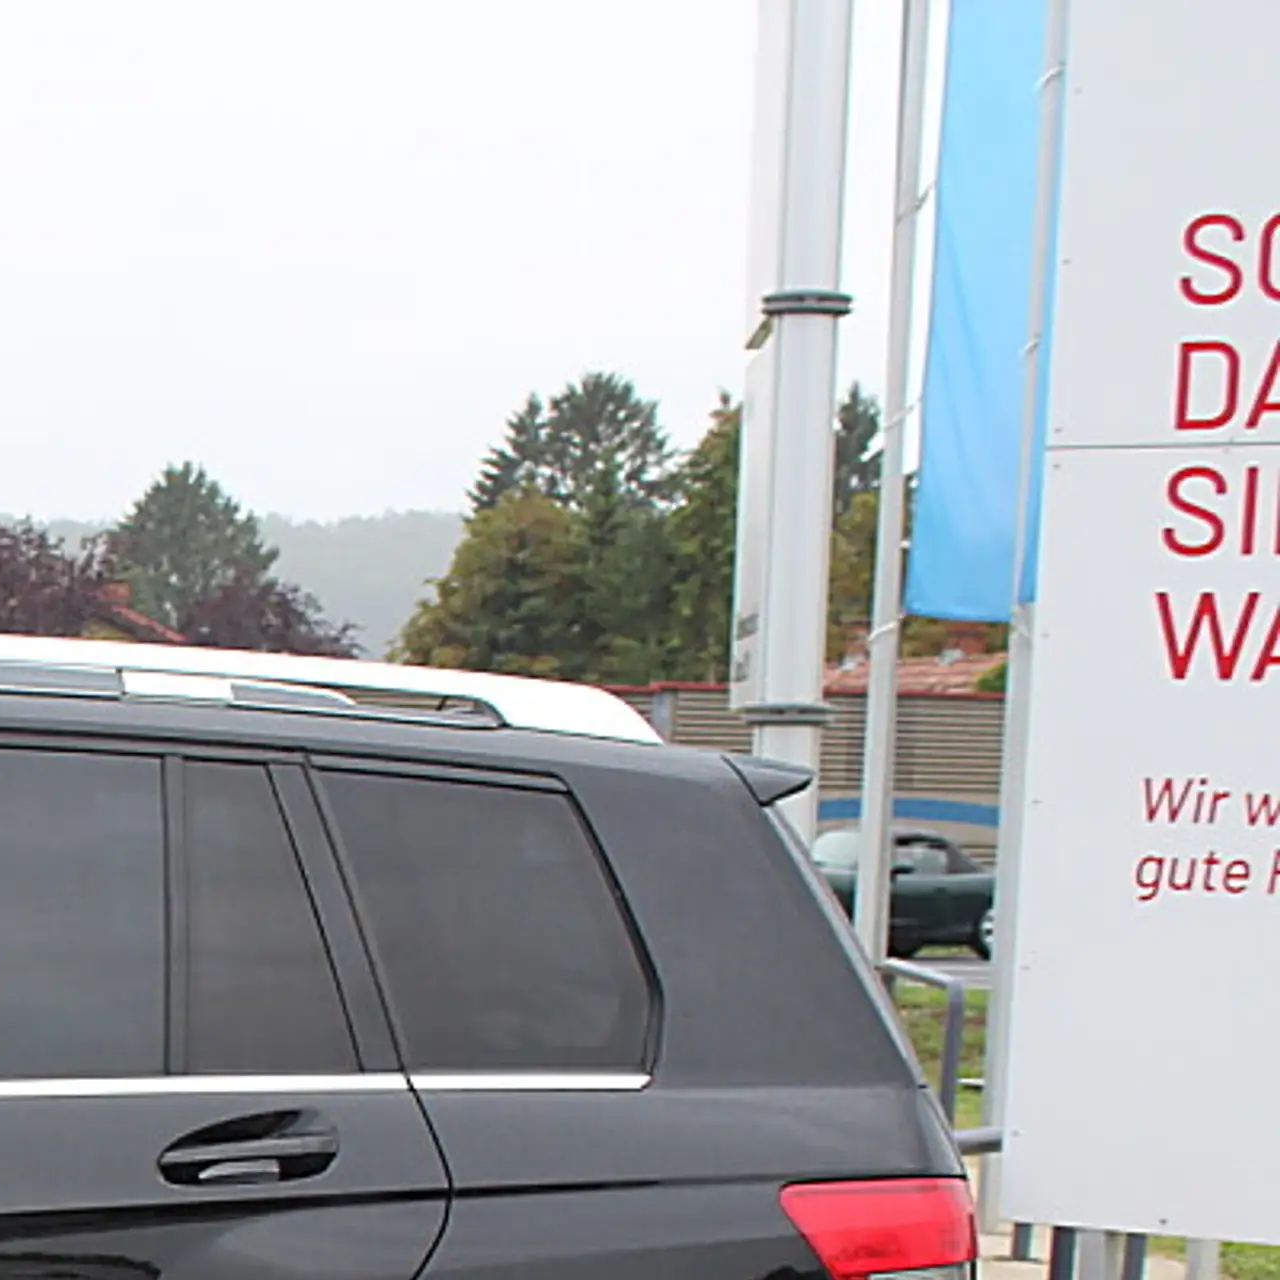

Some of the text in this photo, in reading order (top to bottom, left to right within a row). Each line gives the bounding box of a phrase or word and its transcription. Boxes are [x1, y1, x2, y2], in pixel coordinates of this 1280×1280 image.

[1161, 466, 1280, 557] SI
[1144, 777, 1230, 824] Wir
[1135, 850, 1251, 902] gute
